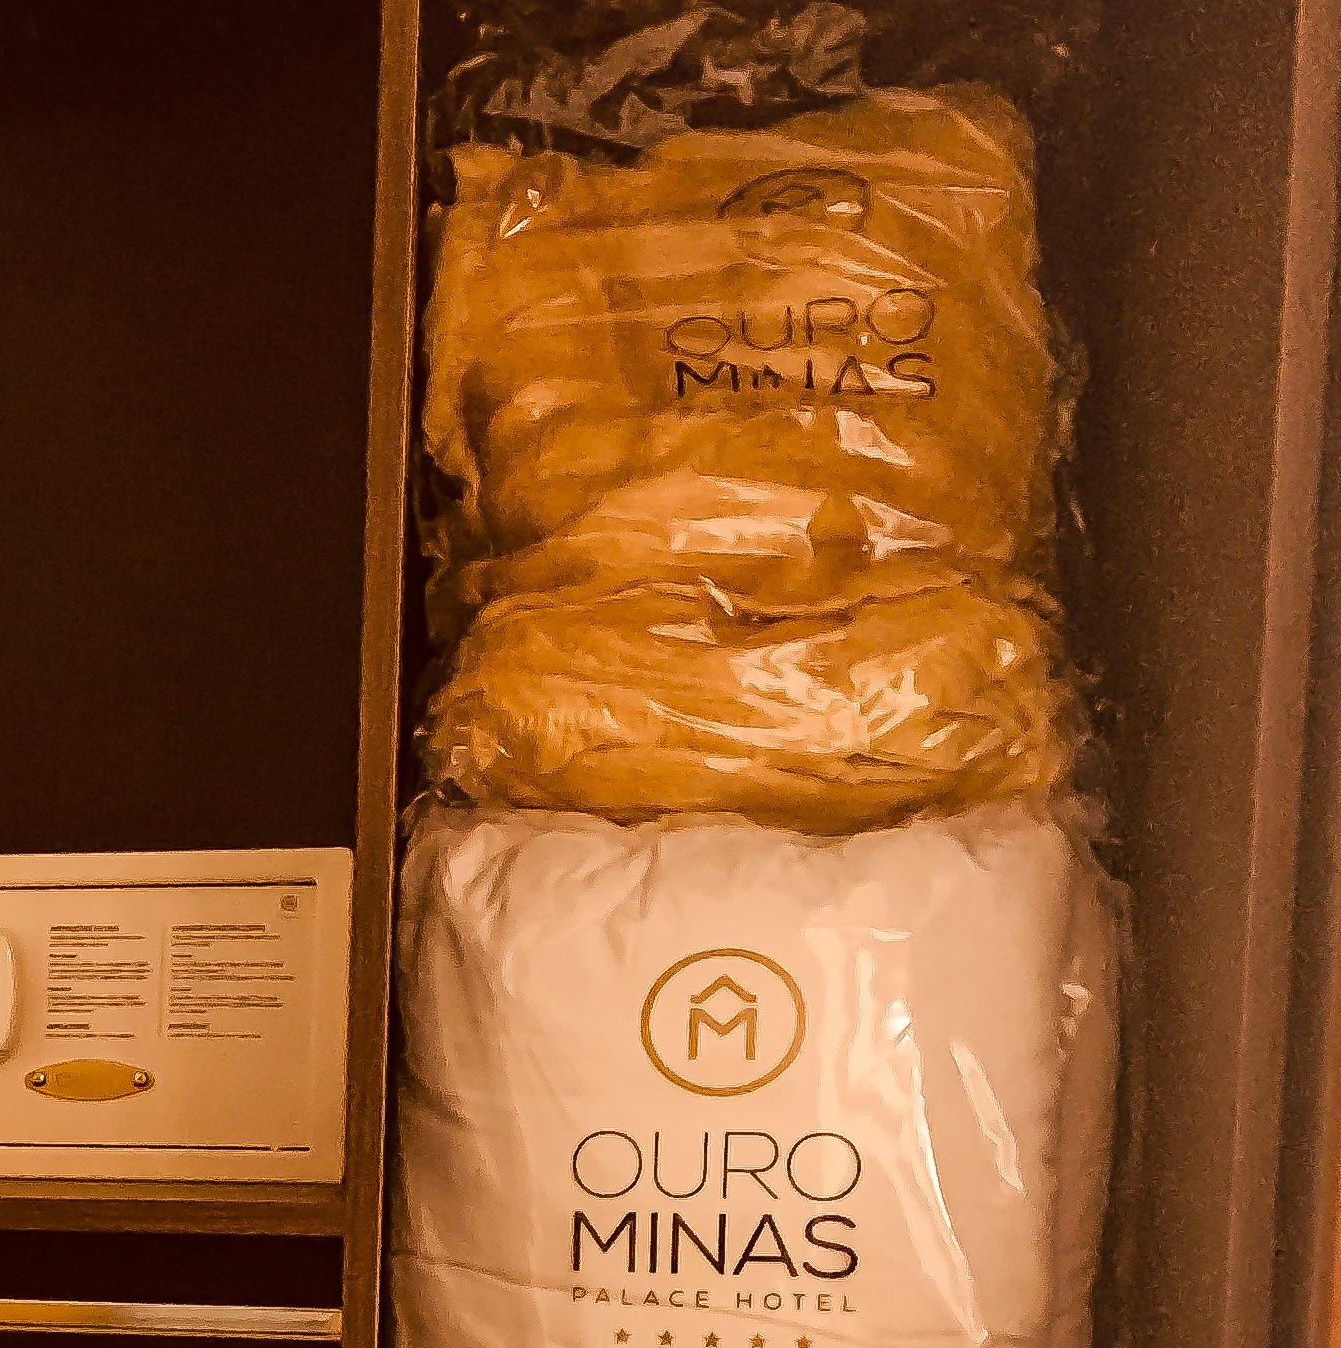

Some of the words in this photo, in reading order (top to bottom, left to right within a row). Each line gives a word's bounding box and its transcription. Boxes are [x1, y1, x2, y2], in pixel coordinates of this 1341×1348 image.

[572, 1130, 862, 1201] OURO
[572, 1211, 859, 1279] MINAS
[571, 1286, 711, 1309] PALACE
[735, 1292, 858, 1312] HOTEL
